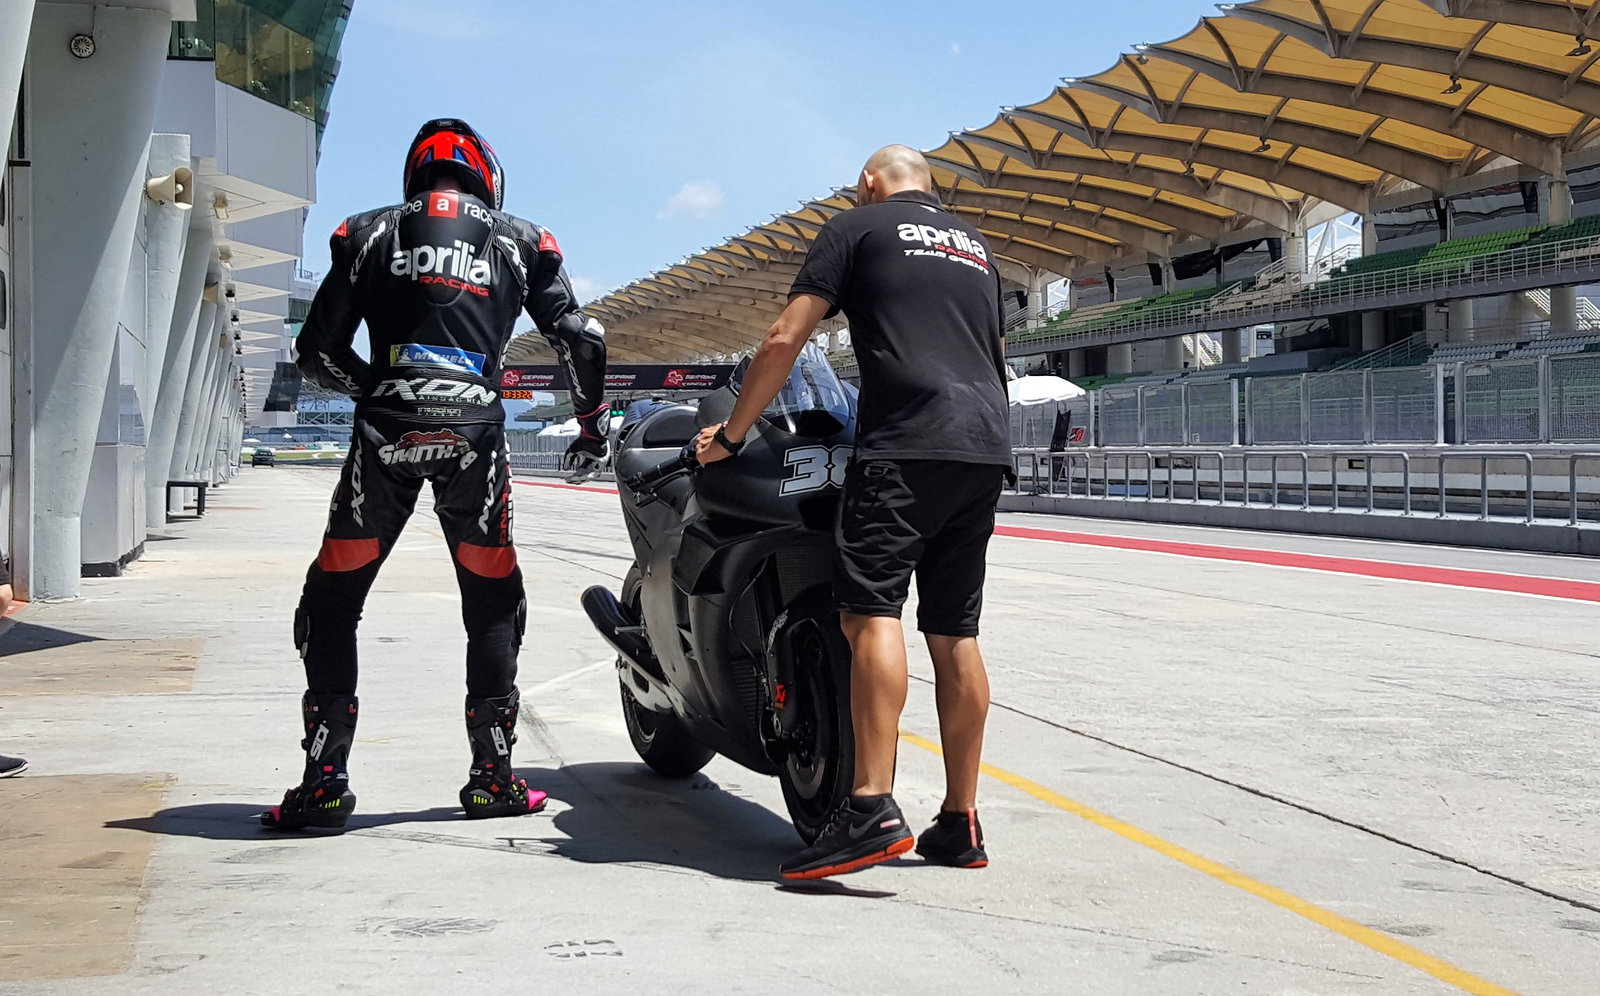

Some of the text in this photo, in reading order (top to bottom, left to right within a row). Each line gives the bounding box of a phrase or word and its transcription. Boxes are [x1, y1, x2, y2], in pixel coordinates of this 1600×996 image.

[897, 223, 988, 262] aprilia
[903, 249, 947, 259] TEAM
[390, 239, 492, 286] aprilia
[934, 244, 990, 270] RACING
[419, 275, 489, 297] RACING
[371, 378, 497, 404] IXON
[490, 726, 509, 756] SIDI
